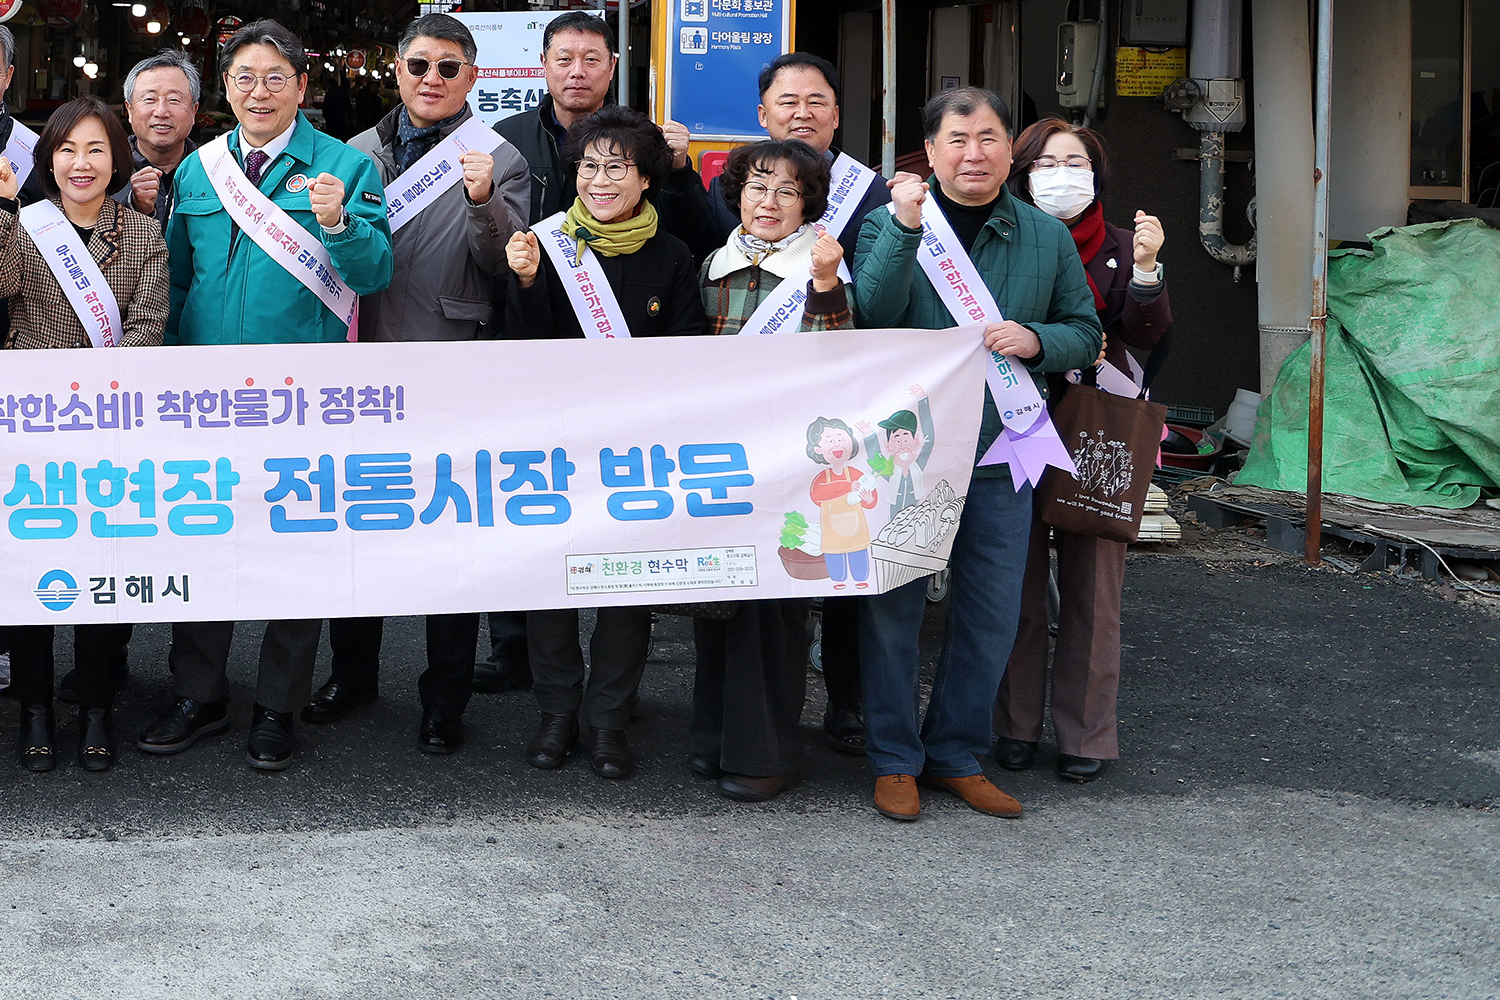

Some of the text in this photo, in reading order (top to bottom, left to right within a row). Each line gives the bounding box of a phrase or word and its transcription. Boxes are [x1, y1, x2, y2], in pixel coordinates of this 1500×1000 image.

[711, 0, 774, 11] 다문화 홍보관
[711, 31, 773, 44] 다어울림 광장
[402, 159, 452, 204] 물가안정을
[830, 164, 862, 206] 물가안정을
[55, 243, 91, 291] 우리동네
[297, 249, 318, 270] 이용
[575, 270, 616, 339] 착한가격업
[938, 257, 986, 324] 착한가격업
[156, 384, 308, 430] 착한물가
[318, 384, 405, 426] 정착!
[1014, 402, 1041, 417] 김해시
[263, 446, 576, 535] 전통시장
[599, 441, 756, 523] 방문
[602, 558, 642, 576] 친환경
[647, 557, 689, 574] 현수막
[88, 574, 191, 606] 김해시
